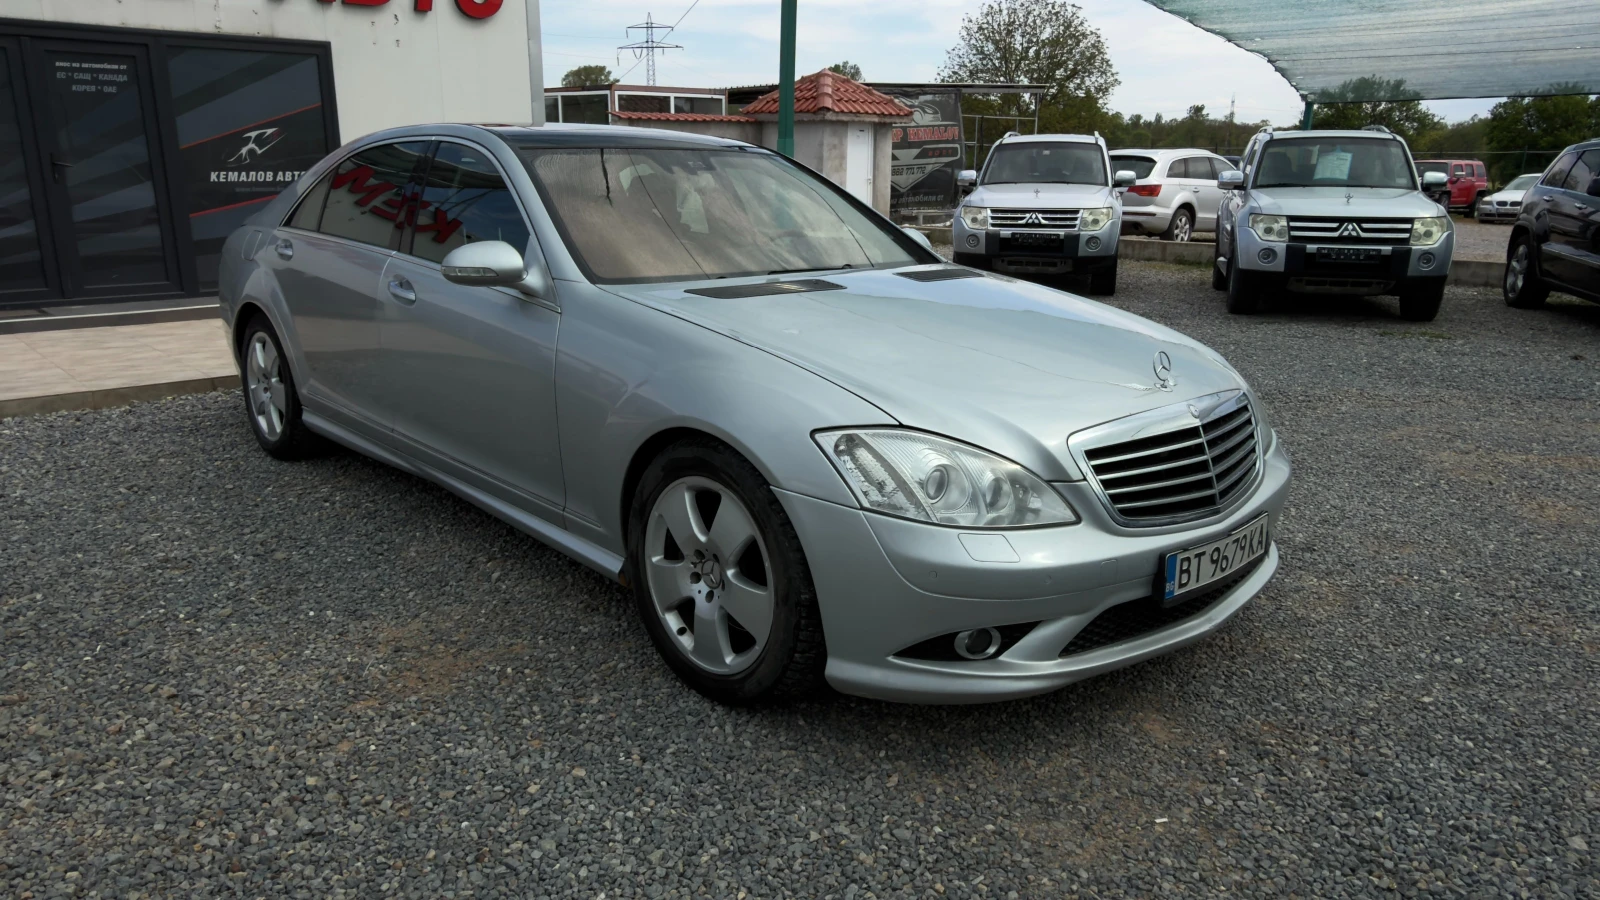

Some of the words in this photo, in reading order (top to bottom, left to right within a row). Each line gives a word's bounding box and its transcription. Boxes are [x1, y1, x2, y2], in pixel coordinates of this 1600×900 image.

[81, 62, 119, 70] автомобили
[56, 71, 67, 79] ЕС
[73, 72, 91, 80] САЩ
[98, 73, 128, 82] КАНАДА
[72, 84, 96, 92] КОРЕЯ
[907, 126, 959, 142] KEMALOV
[916, 166, 926, 175] 772
[210, 171, 273, 182] КЕМАЛОВ
[1178, 551, 1207, 590] BT
[1209, 534, 1248, 578] 9679
[1248, 523, 1264, 559] KA
[1165, 581, 1175, 593] BG
